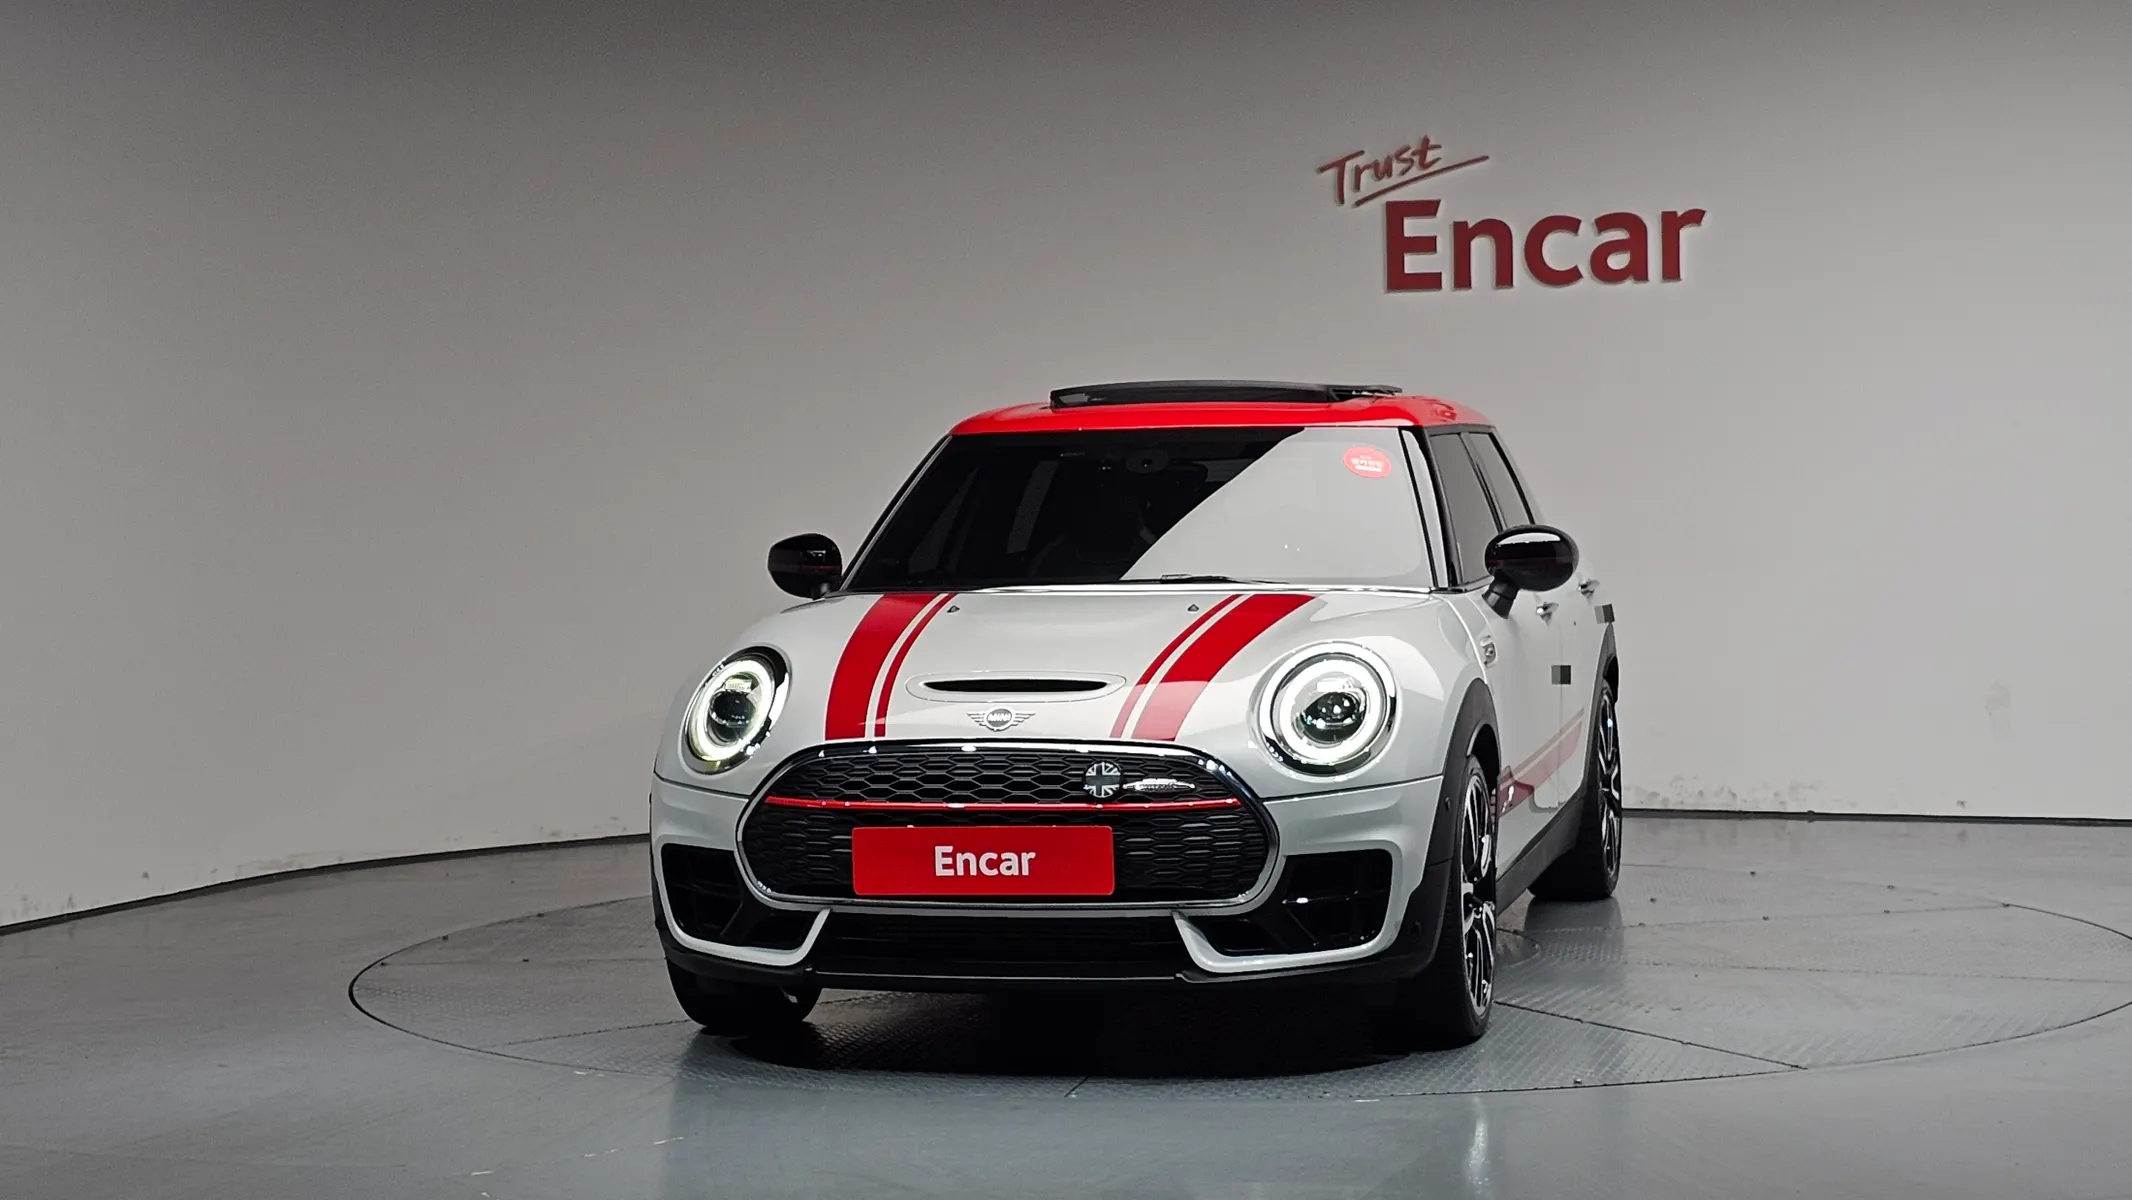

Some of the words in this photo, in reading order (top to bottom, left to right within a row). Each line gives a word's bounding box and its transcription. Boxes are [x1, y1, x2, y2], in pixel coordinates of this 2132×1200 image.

[1317, 134, 1442, 206] Trust
[1384, 199, 1706, 293] Encar
[934, 845, 1036, 876] Encar
